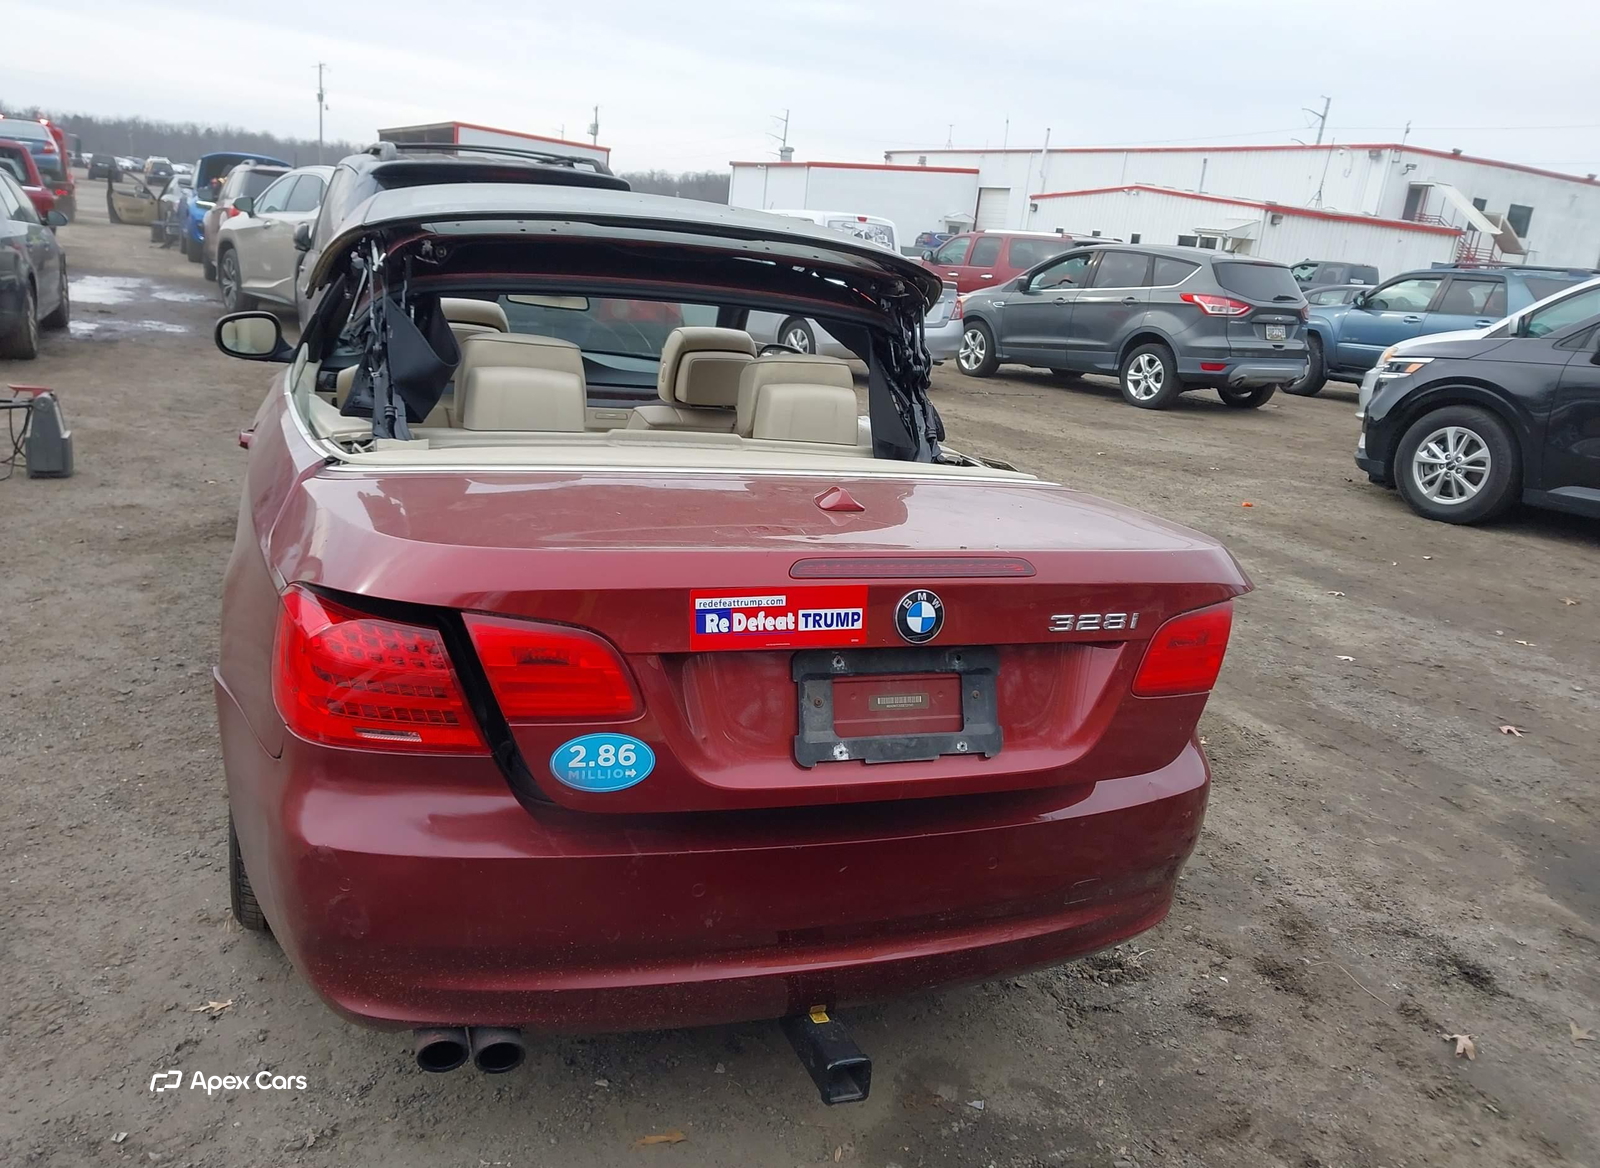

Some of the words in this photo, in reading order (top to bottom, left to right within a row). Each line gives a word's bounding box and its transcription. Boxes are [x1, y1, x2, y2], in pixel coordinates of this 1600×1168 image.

[699, 598, 784, 608] redefeattrump.com
[902, 592, 941, 609] BMW
[801, 611, 861, 629] TRUMP
[1048, 612, 1140, 632] 328i
[568, 743, 637, 768] 2.86
[568, 768, 637, 780] MILLIO
